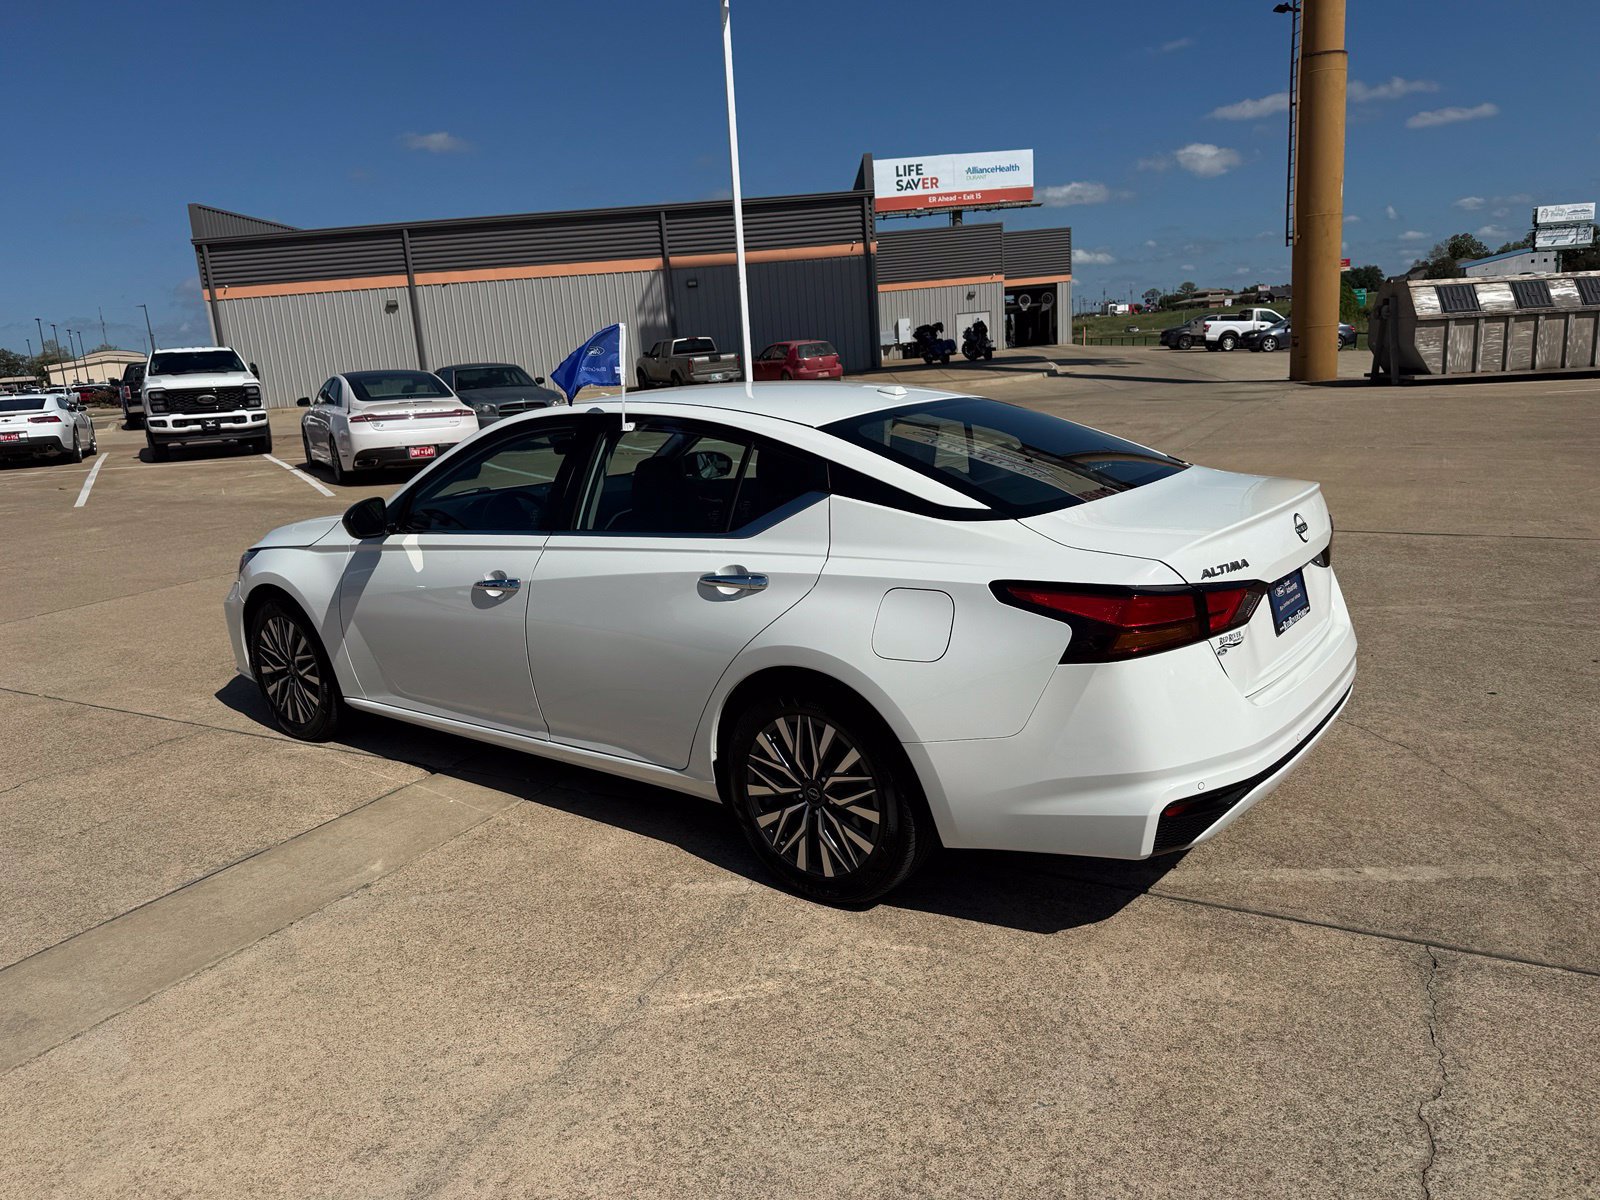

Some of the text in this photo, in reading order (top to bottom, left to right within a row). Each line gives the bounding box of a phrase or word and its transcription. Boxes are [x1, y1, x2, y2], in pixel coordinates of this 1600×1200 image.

[896, 164, 923, 177] LIFE
[966, 163, 1020, 174] AllianceHealth
[896, 177, 939, 191] SAVER
[1201, 558, 1250, 580] ALTIMA
